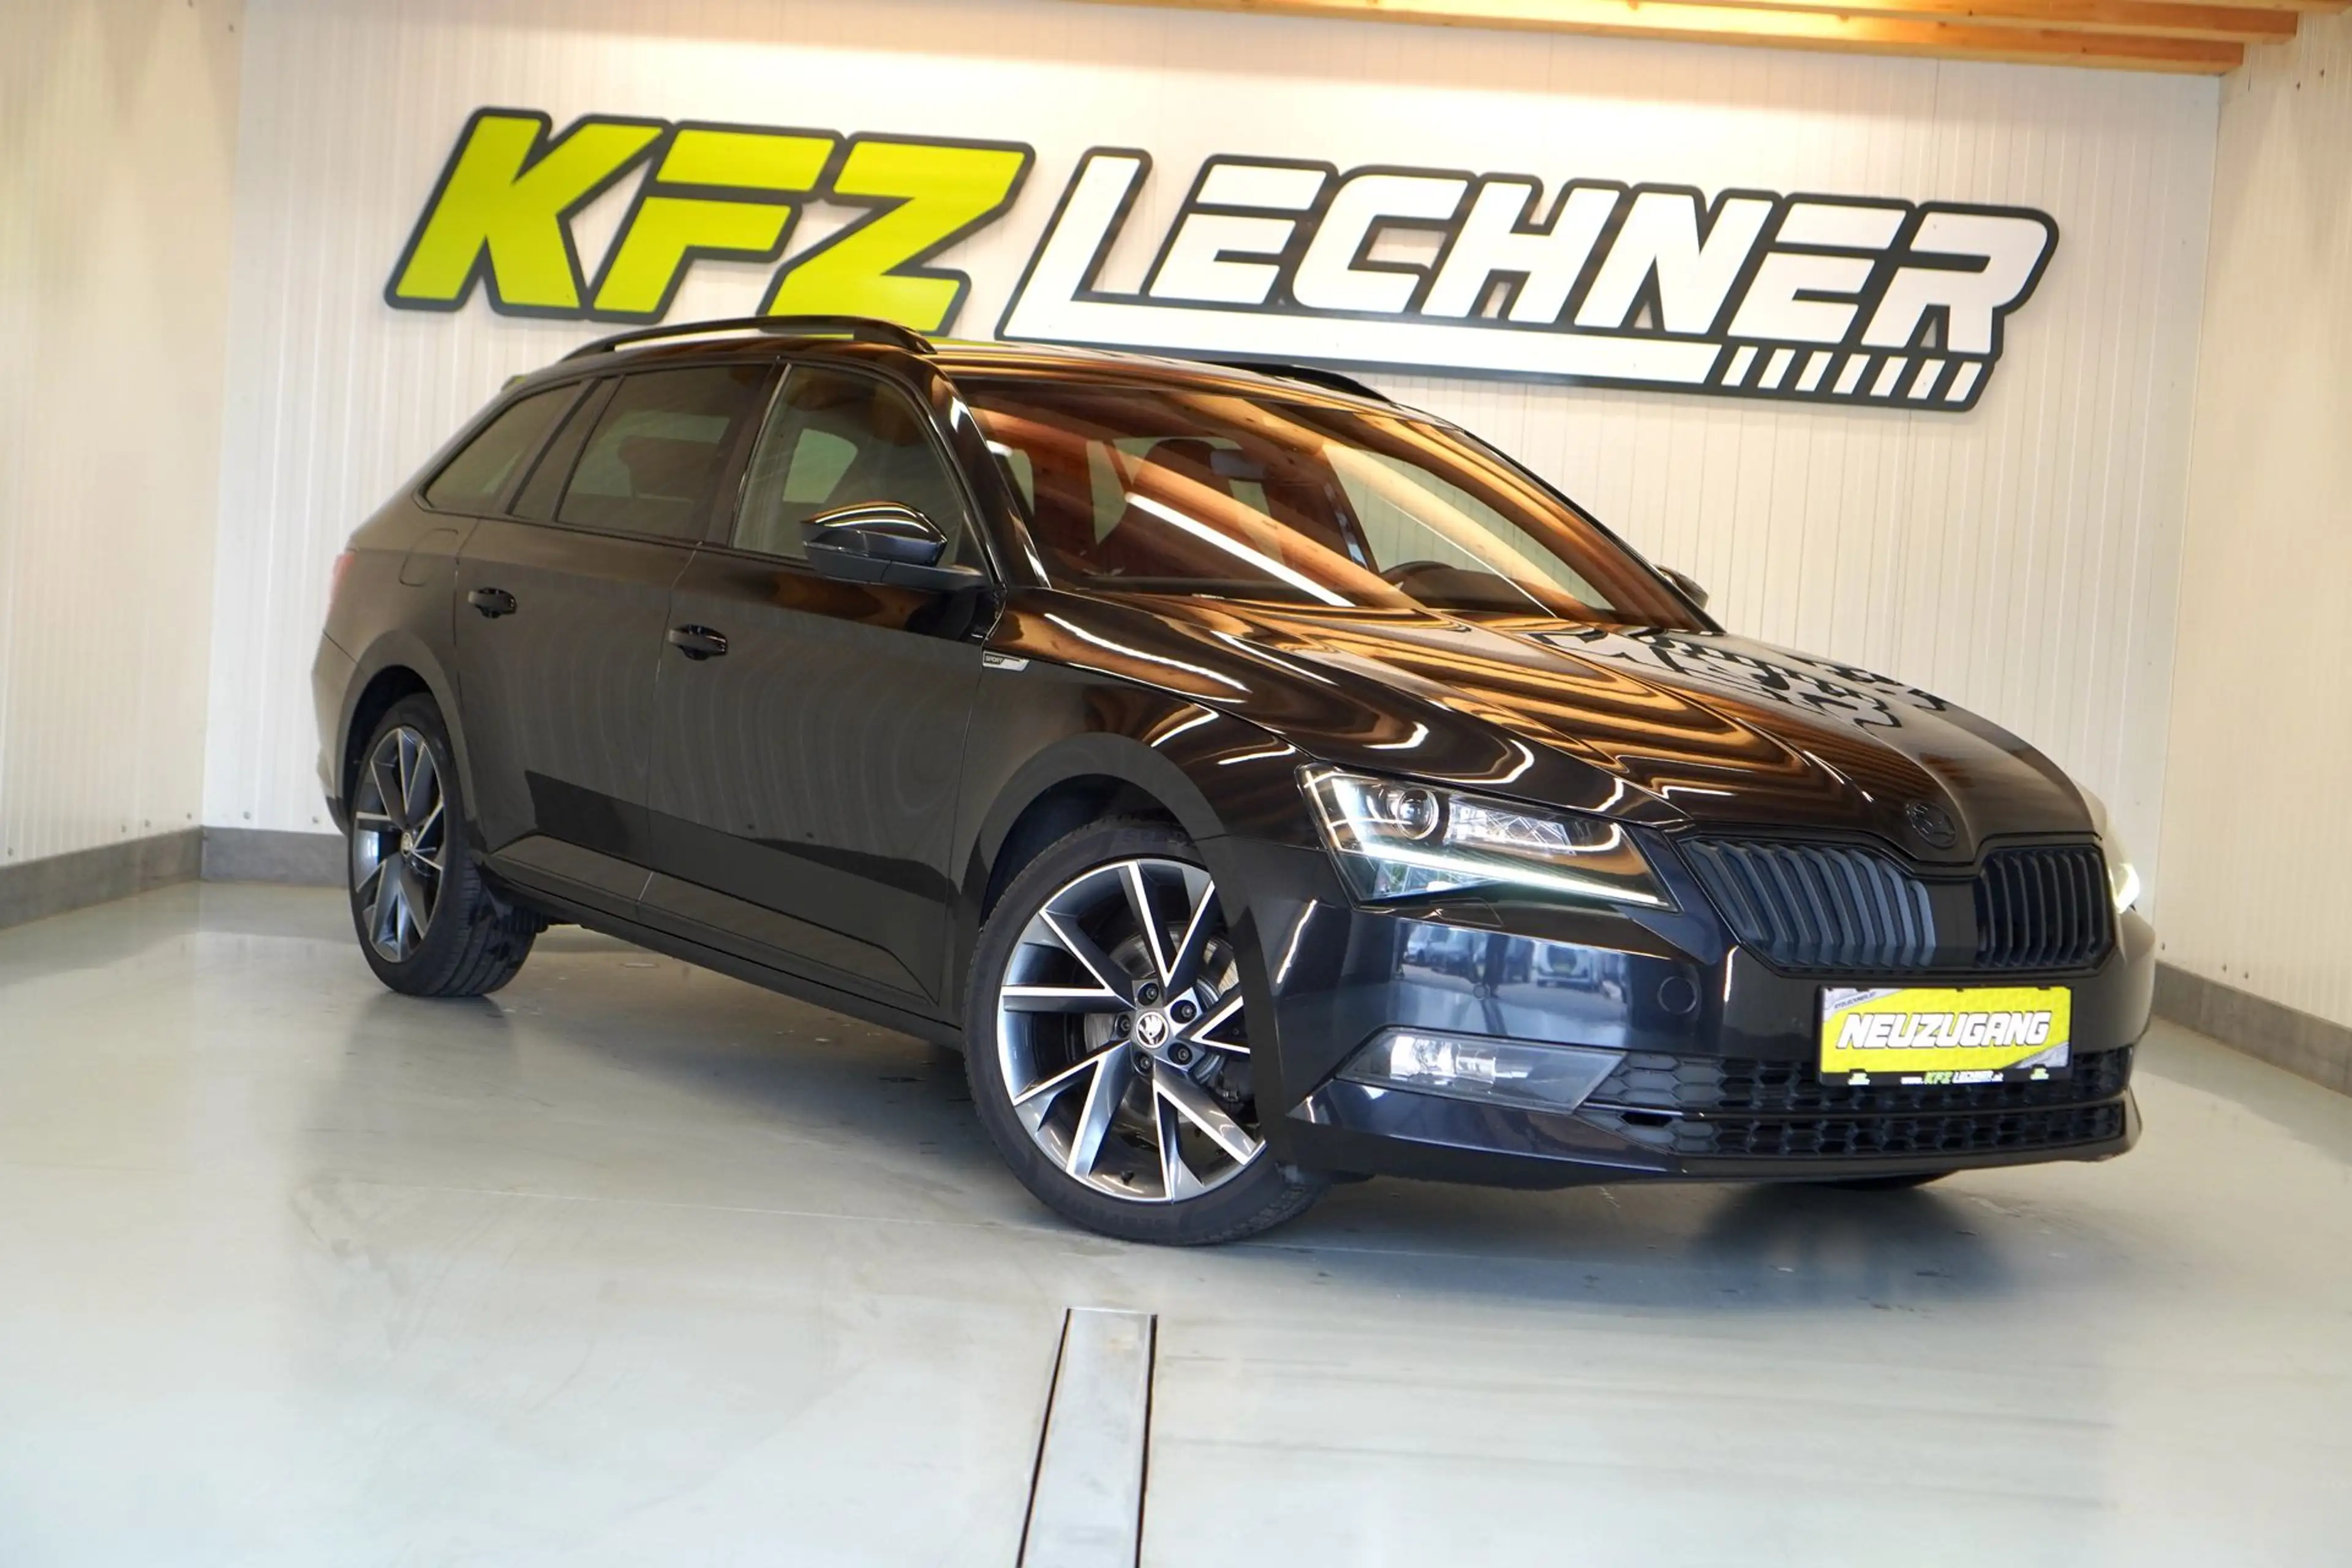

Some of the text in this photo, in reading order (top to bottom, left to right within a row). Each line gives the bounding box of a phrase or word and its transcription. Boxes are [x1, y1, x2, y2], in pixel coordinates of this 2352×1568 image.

[386, 108, 2059, 398] KFZ LECHNER
[1836, 1011, 2052, 1049] NEUZUGANG
